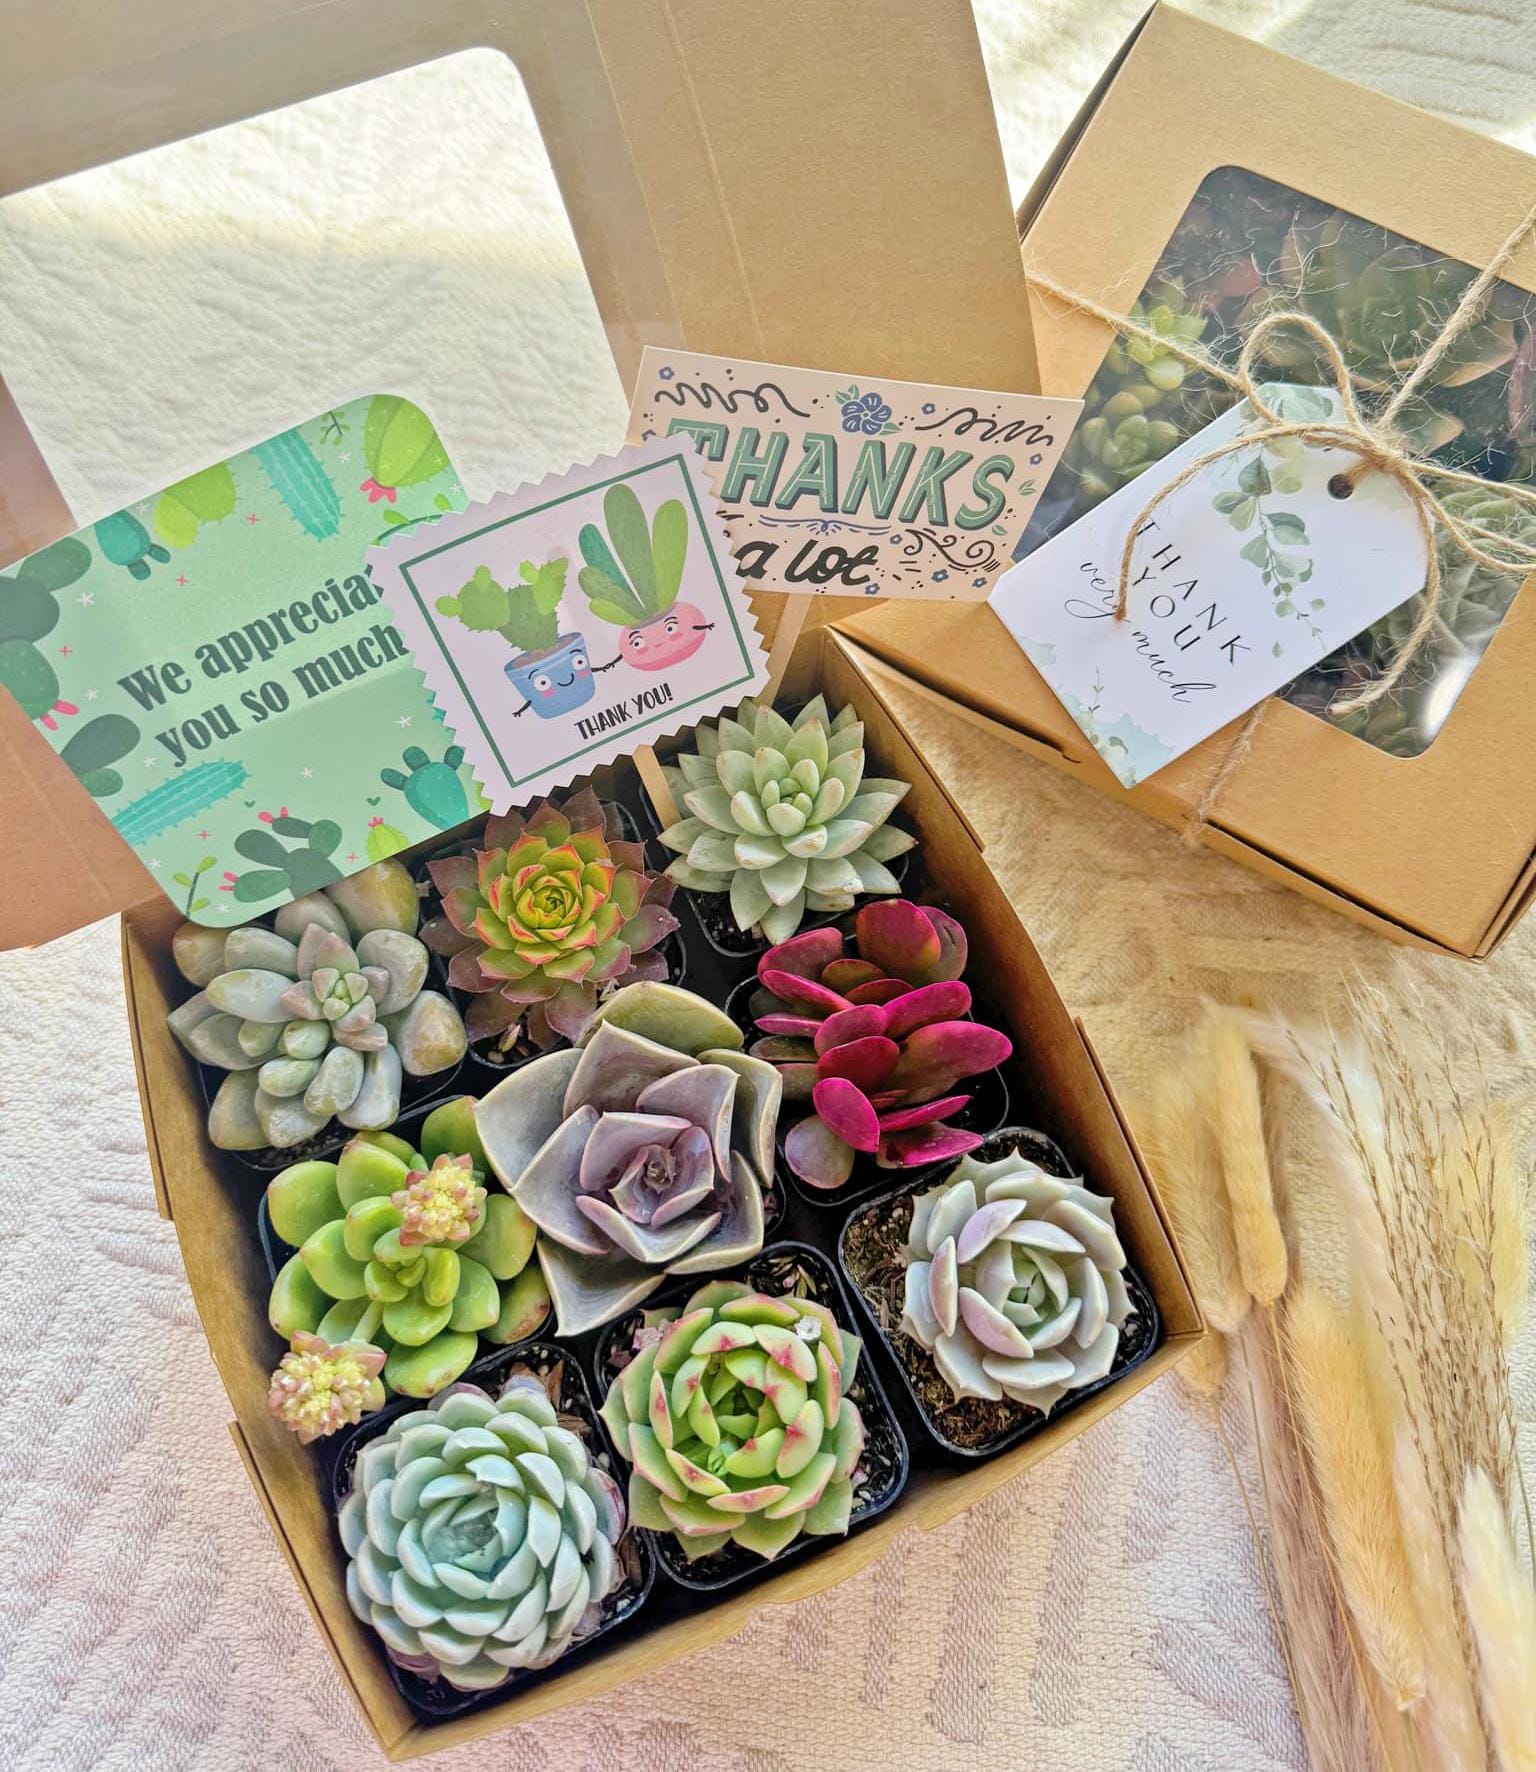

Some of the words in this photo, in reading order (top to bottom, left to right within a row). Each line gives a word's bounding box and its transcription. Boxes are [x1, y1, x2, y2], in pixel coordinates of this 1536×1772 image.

[733, 541, 780, 580] a
[784, 539, 879, 586] lot
[1136, 518, 1251, 665] THANK
[117, 661, 192, 712] We
[194, 563, 384, 679] apprecia
[1132, 566, 1201, 651] YOU
[155, 703, 242, 768] you
[240, 680, 290, 724] so
[291, 624, 410, 699] much
[1132, 631, 1217, 703] much
[574, 701, 633, 740] THANK
[631, 682, 674, 715] YOU!
